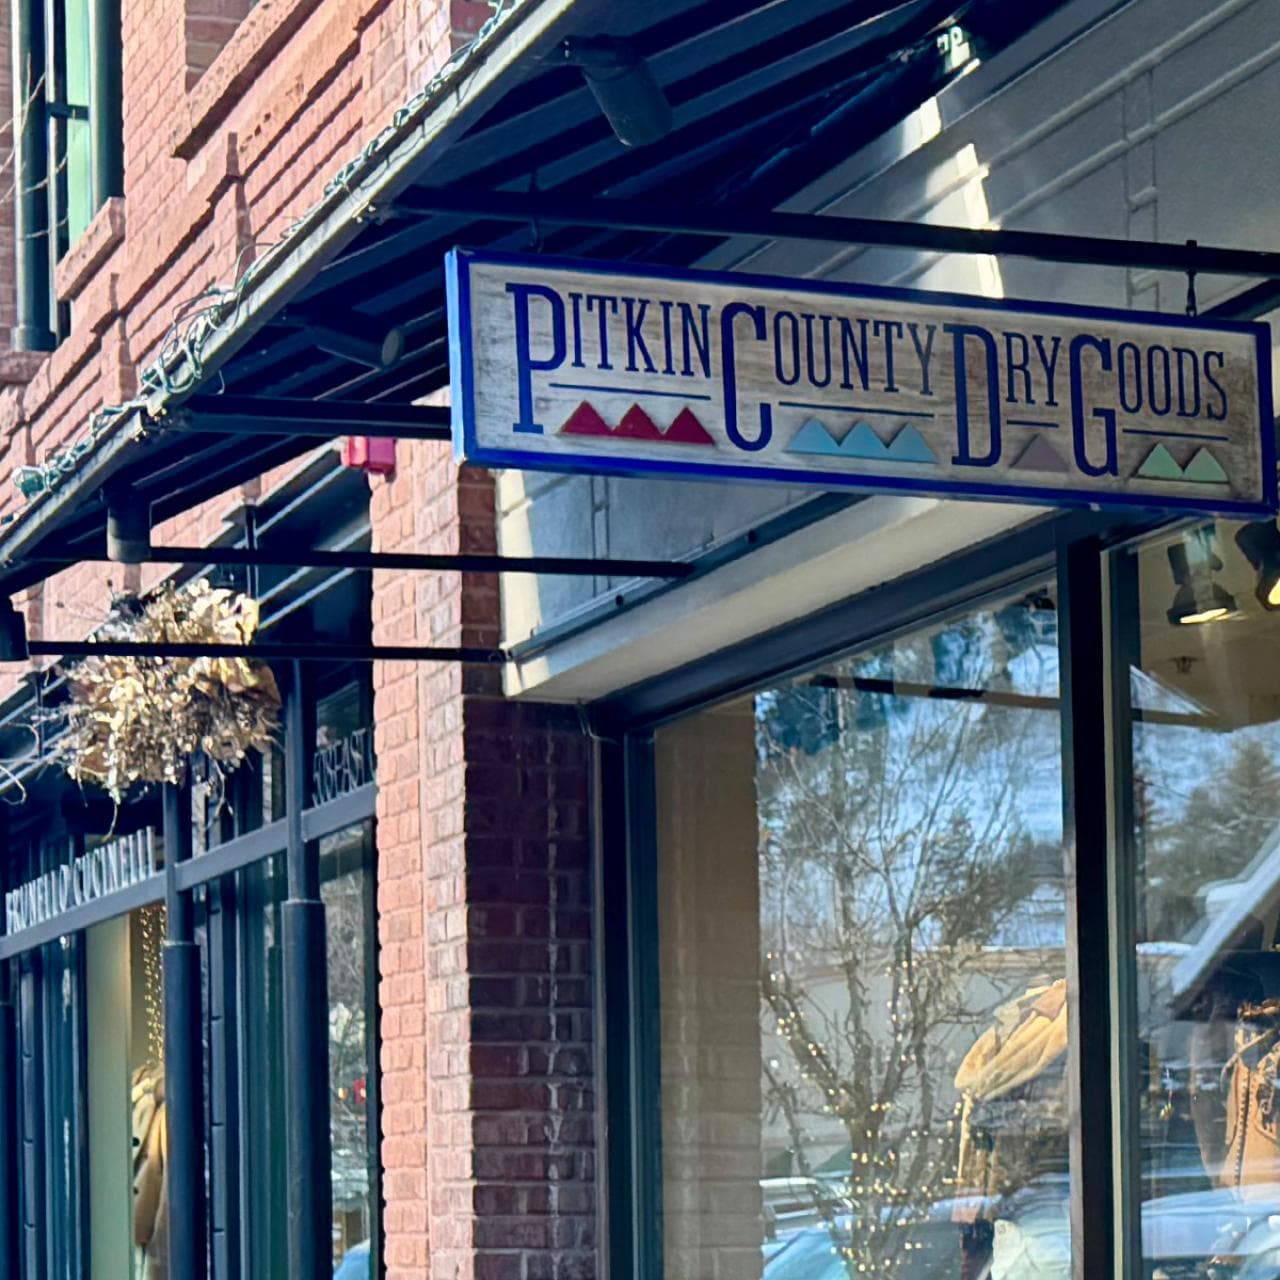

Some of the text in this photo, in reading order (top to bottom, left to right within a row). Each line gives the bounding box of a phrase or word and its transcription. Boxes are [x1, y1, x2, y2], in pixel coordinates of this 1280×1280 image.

[506, 282, 1229, 479] PITKIN COUNTY DRY GOODS
